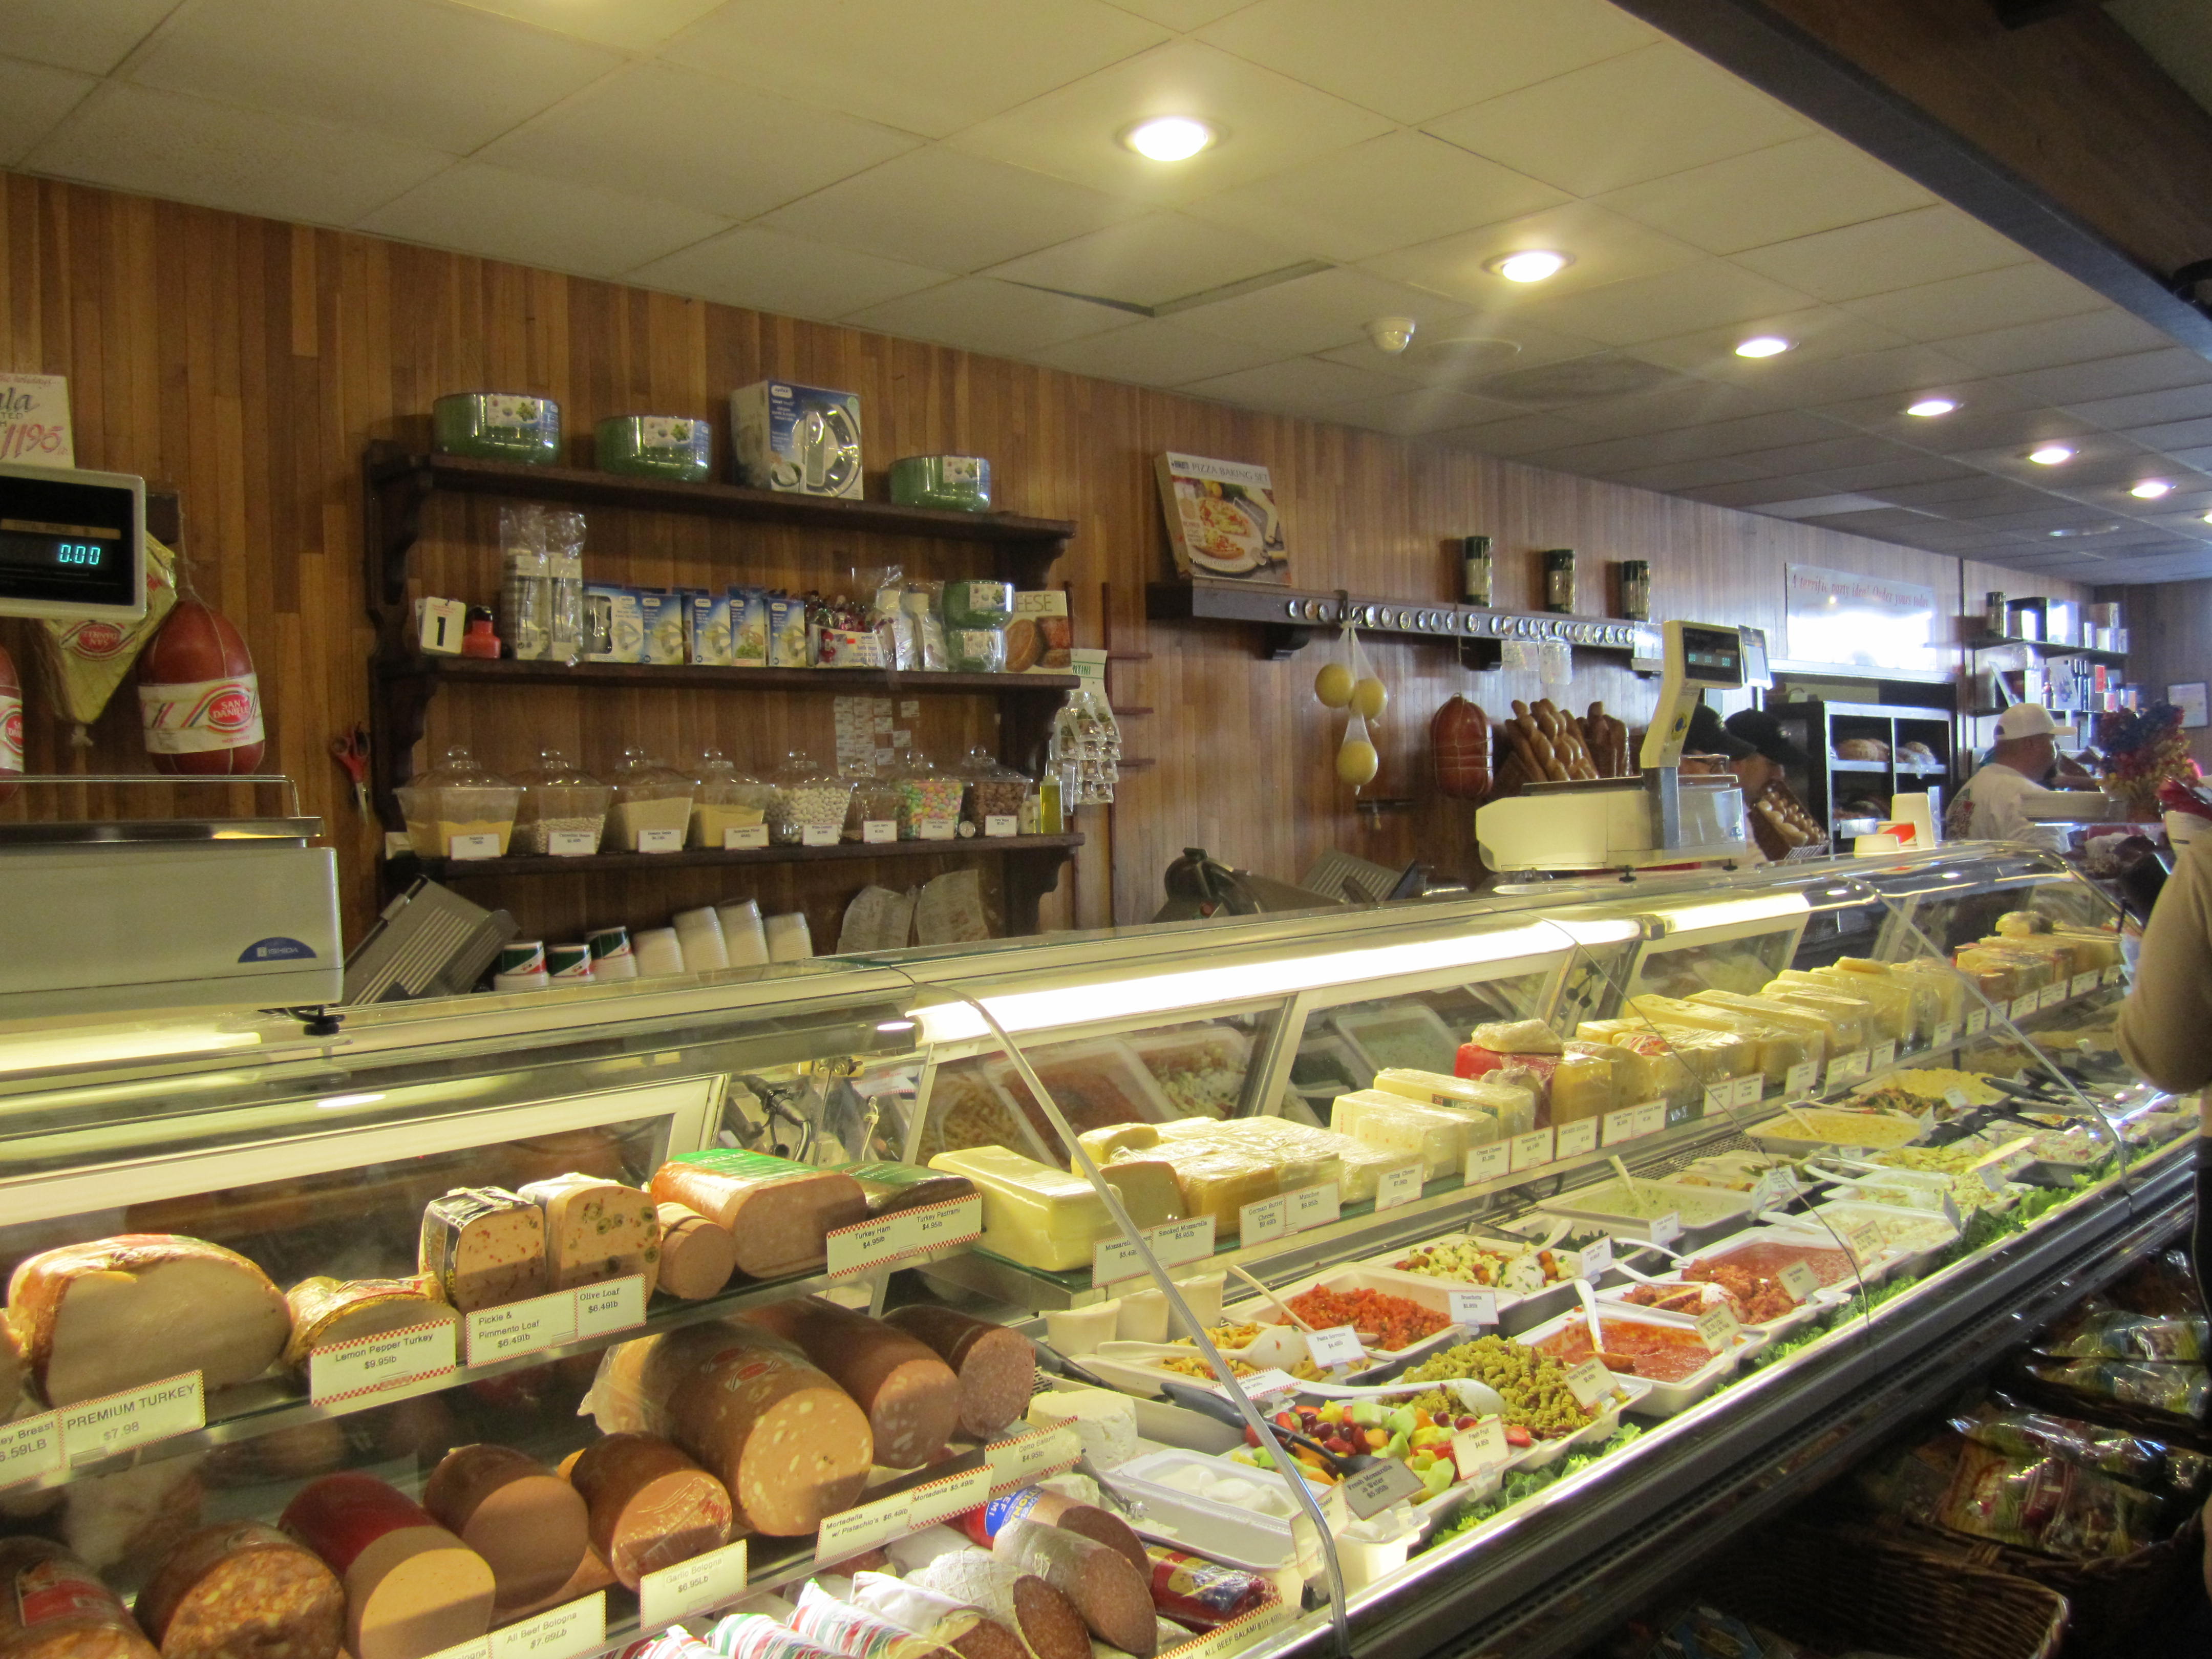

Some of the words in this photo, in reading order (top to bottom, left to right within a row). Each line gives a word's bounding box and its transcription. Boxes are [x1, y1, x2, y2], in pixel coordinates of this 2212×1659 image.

[1192, 462, 1218, 474] PIZZA
[1220, 467, 1253, 480] BAKING
[59, 544, 101, 565] 0.00
[1832, 583, 1849, 598] party
[1015, 594, 1053, 613] EESE
[437, 616, 446, 647] 1
[221, 699, 241, 710] SAN
[917, 1213, 935, 1223] Turkey
[937, 1206, 961, 1218] Pastrami
[1249, 1206, 1267, 1216] German
[1258, 1212, 1274, 1222] Cheese
[855, 1229, 875, 1240] Turkey
[877, 1225, 891, 1235] Ham
[922, 1221, 943, 1231] $4.95lb
[1159, 1227, 1179, 1237] Smoked
[1180, 1220, 1208, 1231] Mozzarella
[862, 1236, 885, 1249] $4.95lb
[579, 1292, 601, 1302] Olive
[602, 1287, 621, 1298] Loaf
[587, 1300, 619, 1314] $6.49lb
[479, 1312, 504, 1326] Pickle
[506, 1311, 513, 1320] &
[479, 1325, 520, 1340] Pimmento
[521, 1320, 540, 1331] Loaf
[335, 1349, 367, 1363] Lemon
[369, 1341, 401, 1354] Pepper
[404, 1333, 434, 1346] Turkey
[497, 1333, 531, 1349] $6.49lb
[364, 1355, 397, 1370] $9.95lb
[67, 1400, 136, 1431] PREMIUM
[139, 1383, 196, 1409] TURKEY
[18, 1421, 55, 1439] Breast
[103, 1421, 140, 1441] $7.98
[1468, 1431, 1480, 1440] Fresh
[1479, 1427, 1490, 1437] Fruit
[1018, 1442, 1035, 1453] Cotto
[1036, 1434, 1056, 1447] Salami
[1347, 1479, 1365, 1491] Fresh
[1368, 1477, 1385, 1489] Water
[914, 1486, 947, 1502] Mortadella
[826, 1513, 863, 1530] Mortadella
[832, 1528, 840, 1538] w/
[841, 1517, 880, 1535] Pistachio's
[691, 1558, 722, 1575] Bologna
[506, 1633, 519, 1644] All
[520, 1625, 541, 1639] Beef
[542, 1611, 578, 1631] Bologna
[1217, 1637, 1233, 1651] BEEF
[1233, 1623, 1257, 1642] SALAMI
